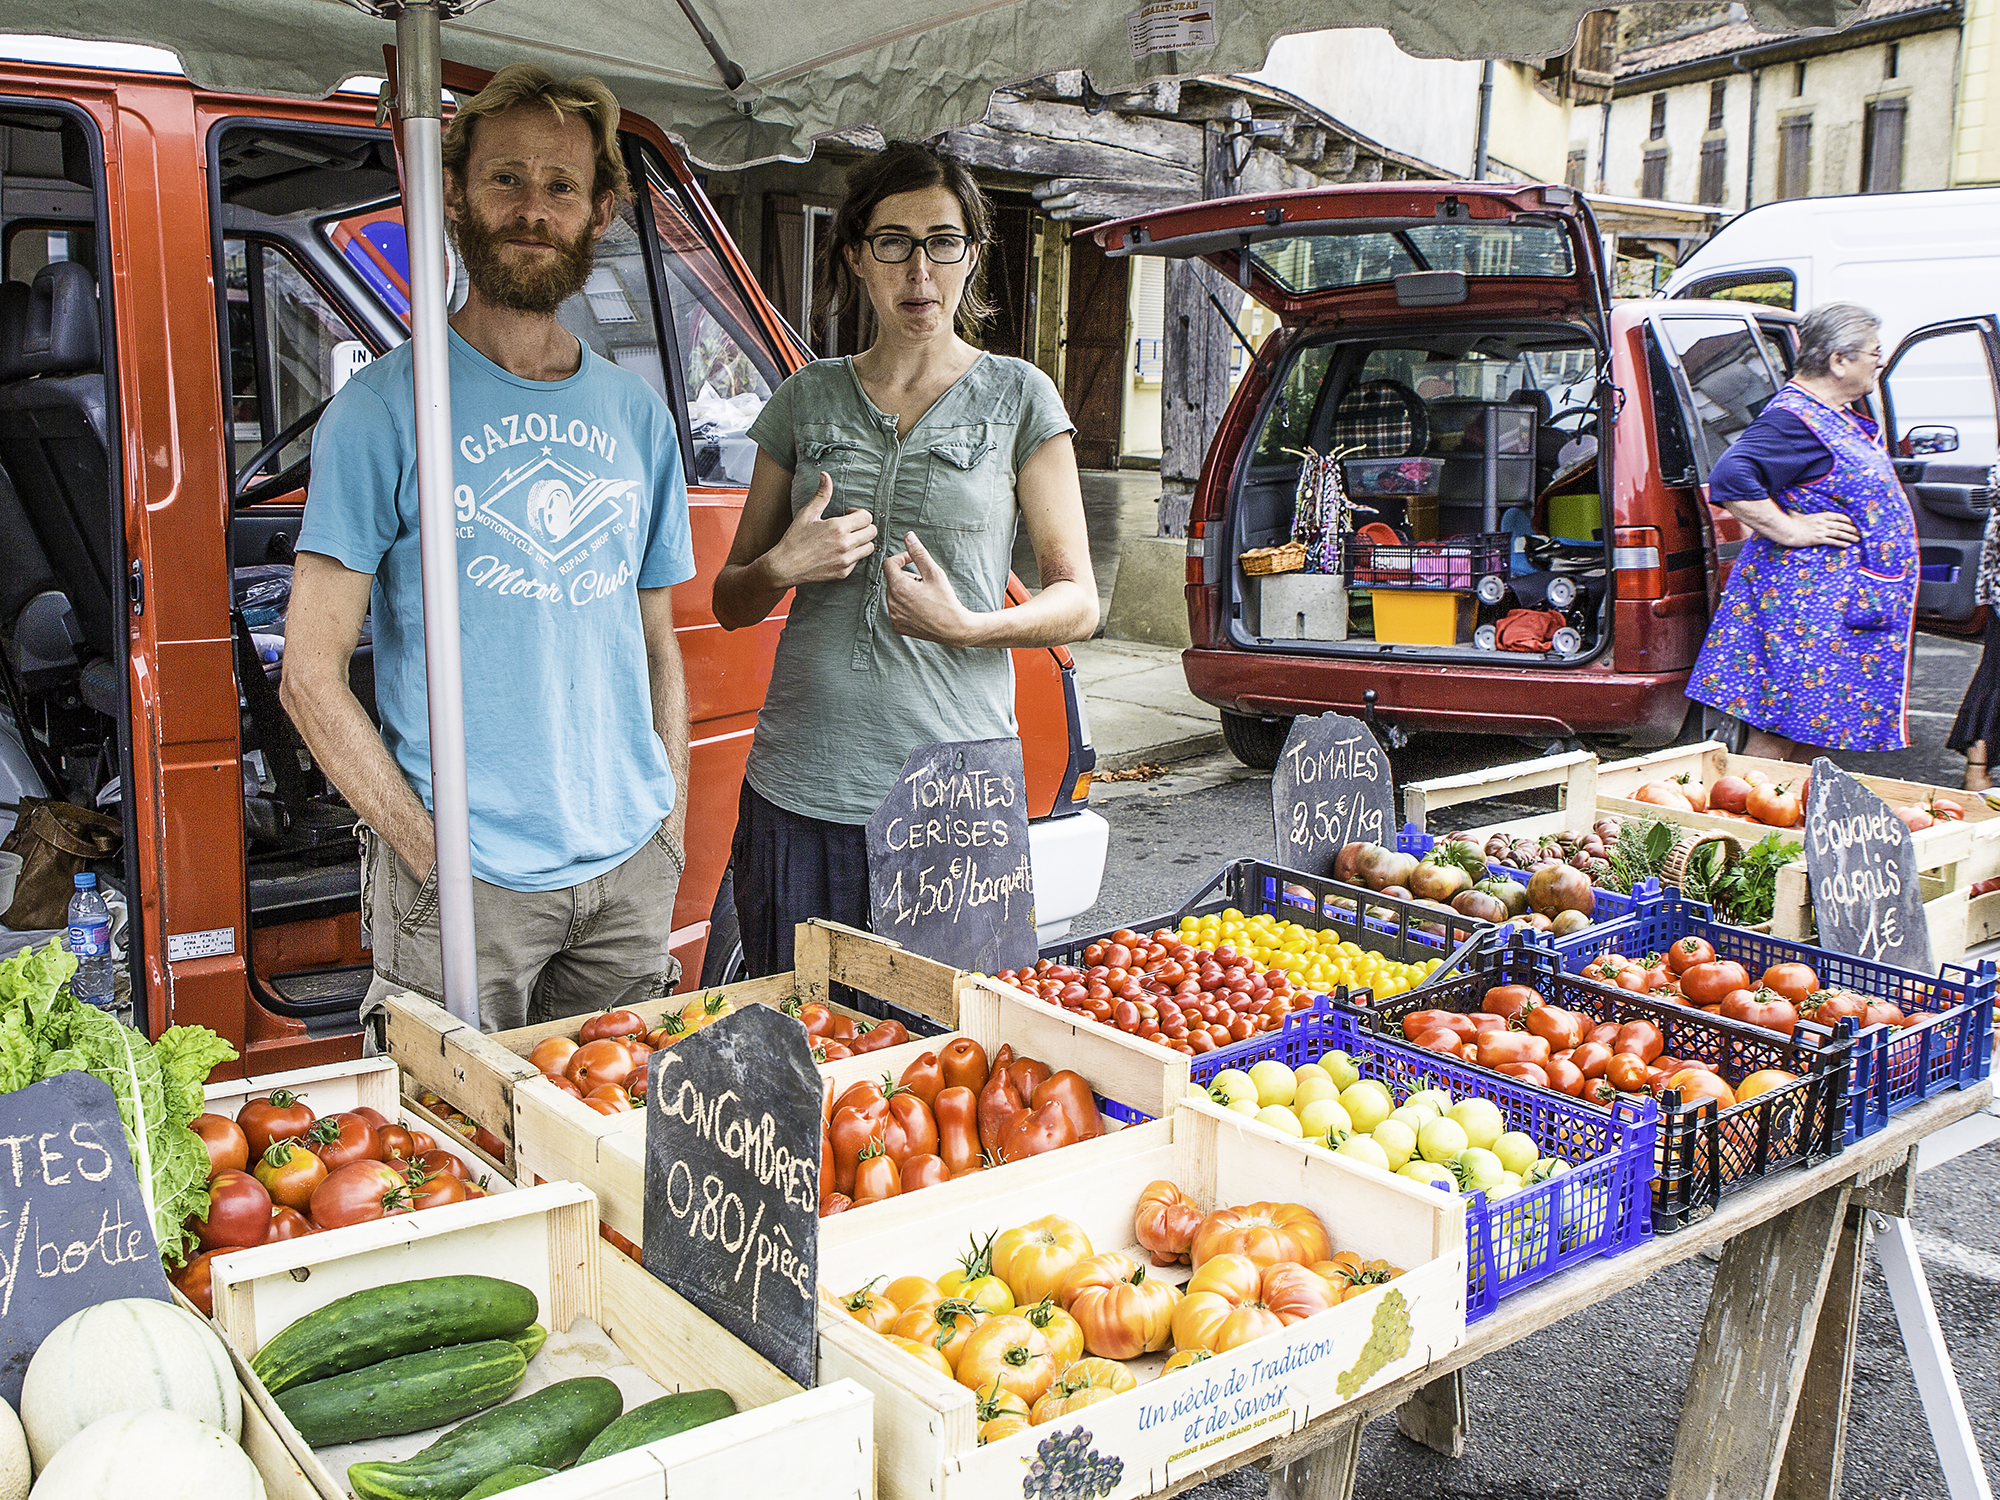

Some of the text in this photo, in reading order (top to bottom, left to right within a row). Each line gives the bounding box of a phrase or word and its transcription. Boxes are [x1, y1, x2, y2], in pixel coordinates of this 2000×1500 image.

[353, 350, 366, 363] IN
[460, 413, 617, 464] GAZOLONI
[474, 510, 549, 571] MOTORCYCLE INC.
[558, 549, 590, 576] REPAIR
[590, 532, 610, 553] SHOP
[611, 522, 625, 536] CO.
[466, 555, 633, 606] Motor Club
[1286, 735, 1379, 786] TOMATES
[904, 766, 1015, 812] TOMATES
[1290, 791, 1383, 852] 2,50€/kg
[1811, 802, 1902, 866] Bouquets
[1820, 853, 1901, 928] garnis
[1858, 907, 1905, 961] 1€
[657, 1051, 815, 1213] CONCOMBRES
[1139, 1339, 1335, 1431] Un siècle de Tradition
[1168, 1408, 1290, 1463] ORIGINE BASSIN GRAND SUD OUEST
[1184, 1384, 1288, 1444] et de Savoir
